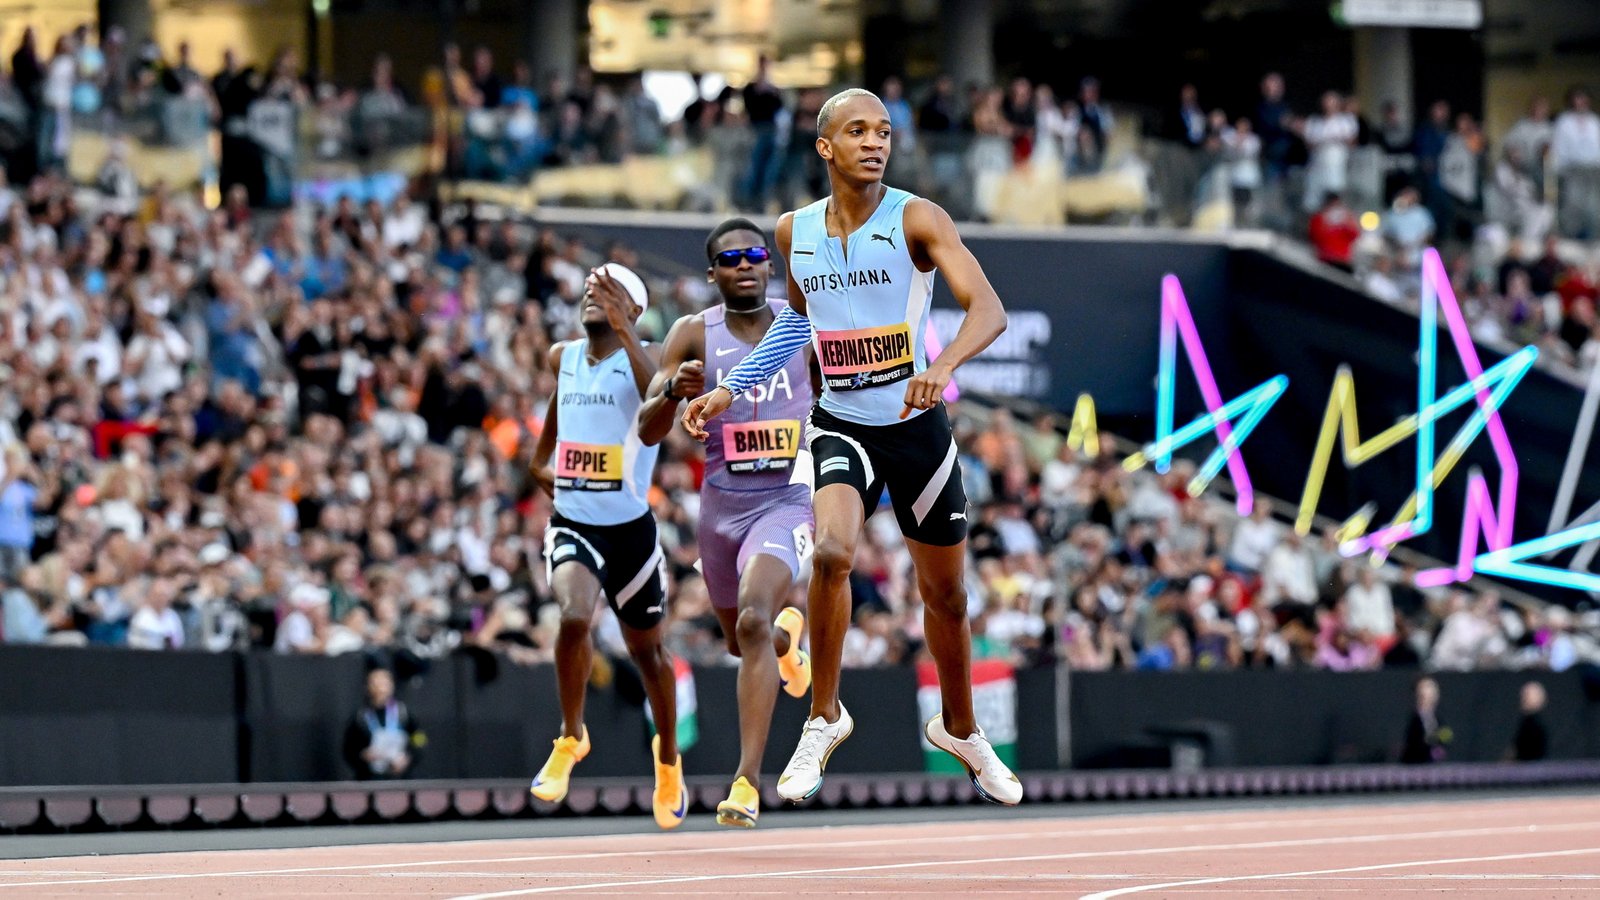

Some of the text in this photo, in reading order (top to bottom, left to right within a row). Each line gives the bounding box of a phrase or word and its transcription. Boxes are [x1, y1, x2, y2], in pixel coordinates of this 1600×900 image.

[803, 269, 892, 294] BOTSWANA
[820, 331, 910, 367] KEBINATSHIPI
[871, 369, 901, 383] BUDAPEST
[561, 392, 615, 406] BOTSWANA
[733, 428, 793, 453] BAILEY
[565, 449, 608, 473] EPPIE
